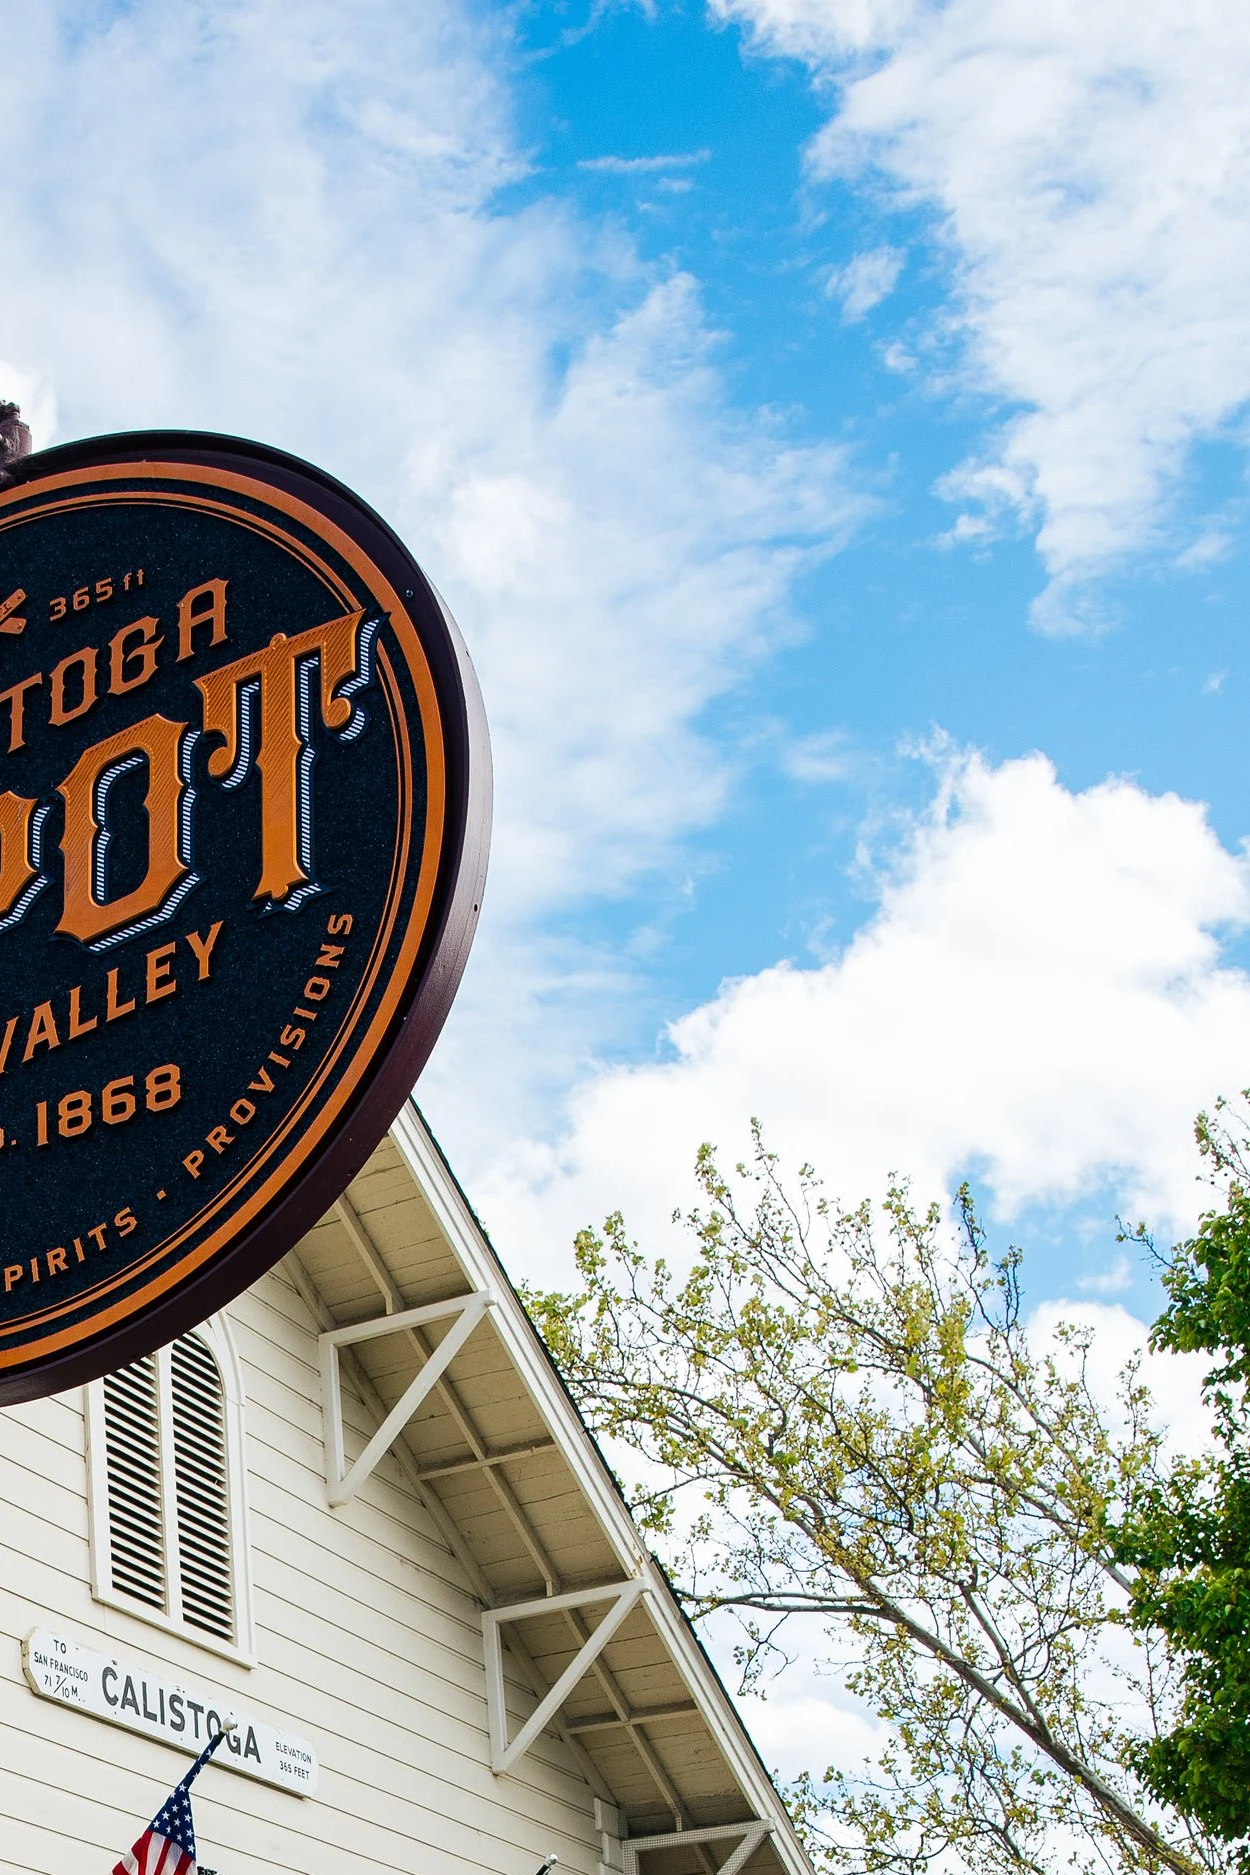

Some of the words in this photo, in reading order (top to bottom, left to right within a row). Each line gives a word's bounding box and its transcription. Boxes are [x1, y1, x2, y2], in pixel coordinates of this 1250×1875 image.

[181, 911, 355, 1180] PROVISIONS
[34, 1063, 183, 1147] 1868
[53, 1639, 67, 1654] TO
[33, 1651, 48, 1667] SAN
[49, 1657, 89, 1682] FRANCISCO
[101, 1666, 262, 1764] CALISTOGA
[275, 1741, 312, 1765] ELEVATION
[279, 1760, 292, 1774] 365
[293, 1764, 310, 1780] FEET
